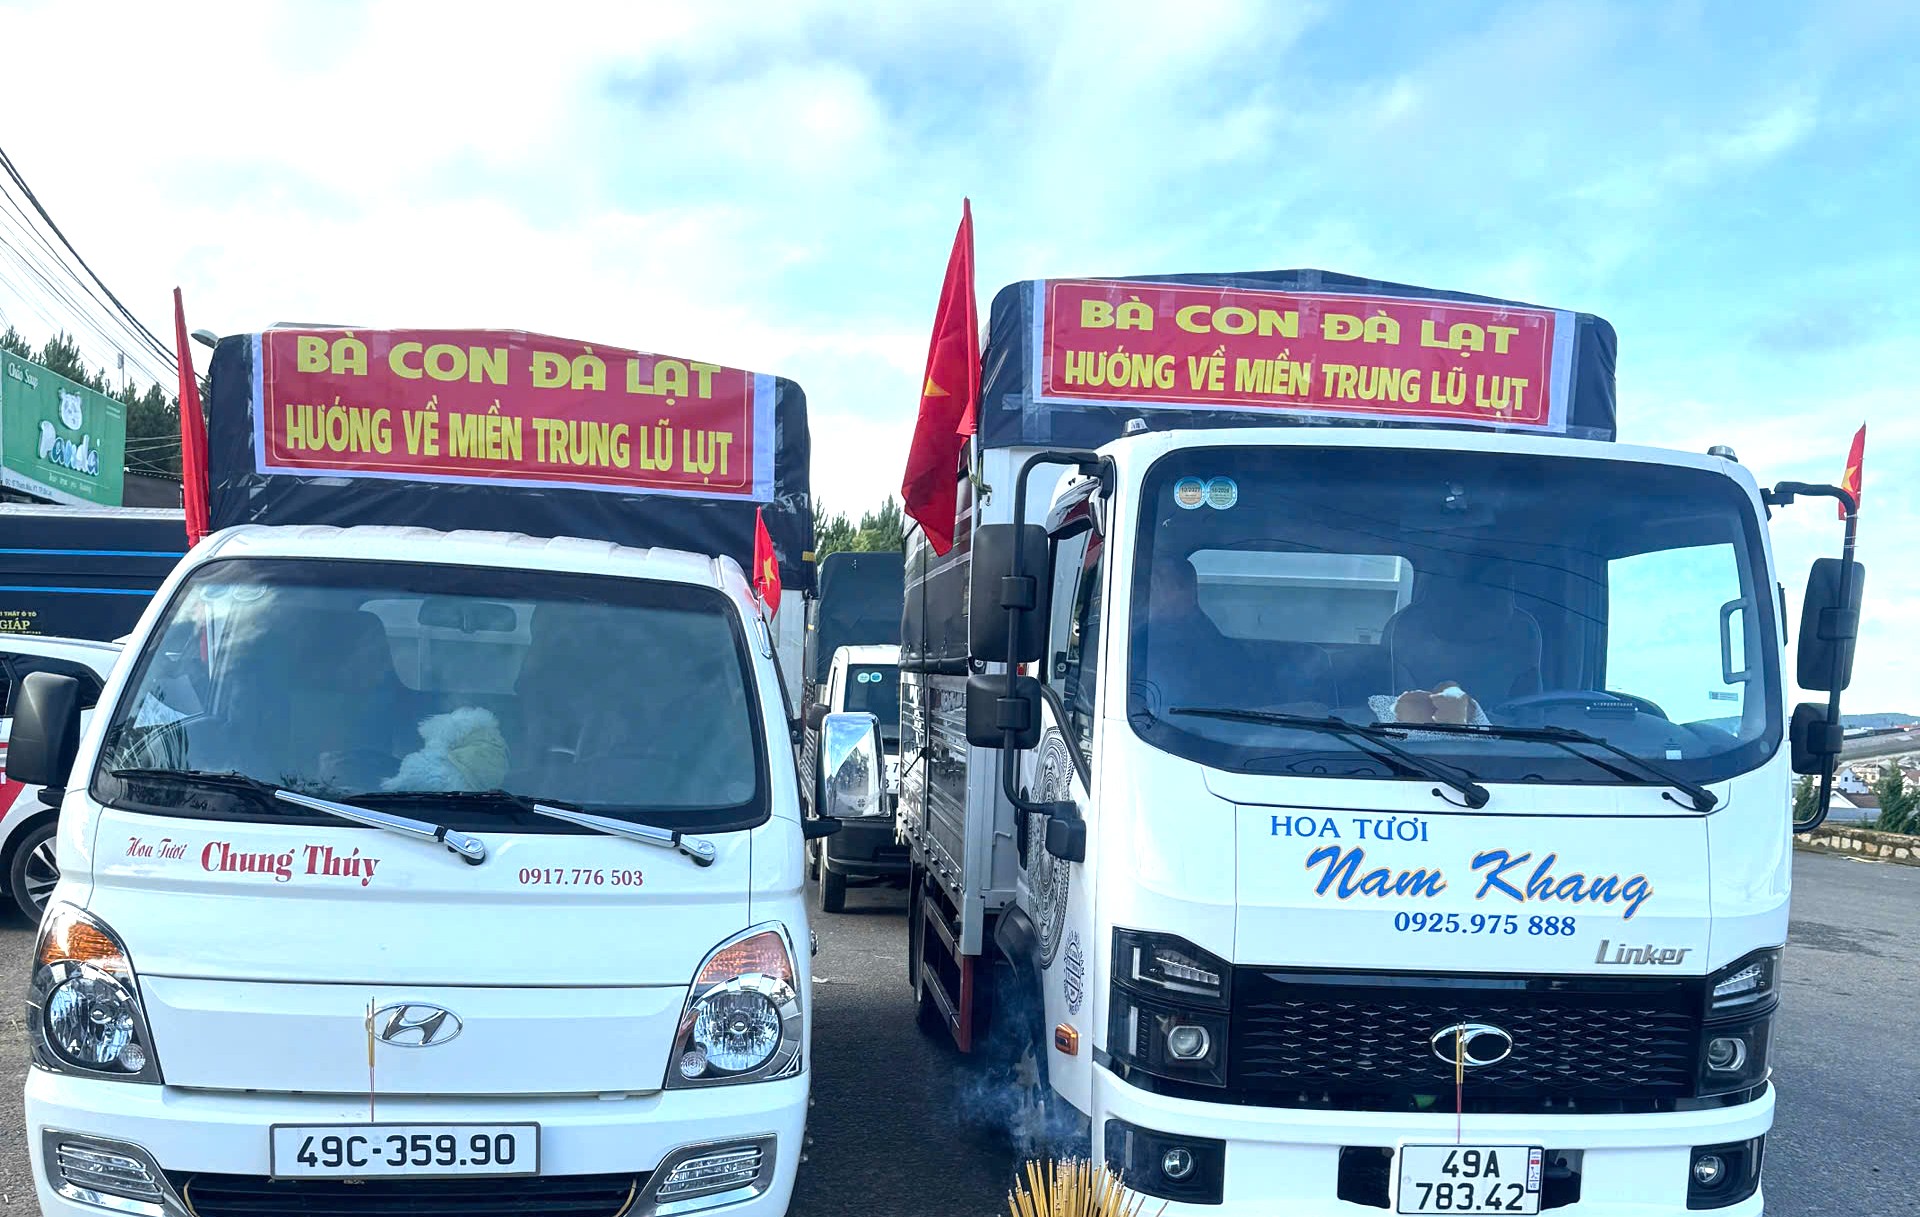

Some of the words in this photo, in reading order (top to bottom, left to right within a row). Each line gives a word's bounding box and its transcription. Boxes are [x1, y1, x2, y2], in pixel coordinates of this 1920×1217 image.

[1080, 295, 1154, 331] BÀ
[1175, 305, 1300, 338] CON
[1320, 309, 1401, 344] ĐÀ
[1421, 320, 1518, 358] LẠT
[297, 331, 367, 376] BÀ
[388, 342, 508, 385] CON
[529, 348, 606, 391] ĐÀ
[626, 360, 721, 405] LẠT
[1065, 346, 1175, 389] HƯỚNG
[1188, 344, 1225, 391] VỀ
[1235, 347, 1311, 396] MIỀN
[1322, 364, 1420, 403] TRUNG
[1430, 370, 1466, 405] LŨ
[1475, 376, 1528, 418] LỤT
[39, 420, 99, 476] Panda
[285, 396, 392, 454] HƯỚNG
[402, 395, 439, 456] VỀ
[448, 400, 523, 461] MIỀN
[532, 417, 630, 468] TRUNG
[639, 419, 673, 471] LŨ
[682, 430, 733, 484] LỤT
[0, 617, 30, 630] GIÁP
[1271, 815, 1341, 839] HOA
[1352, 815, 1429, 843] TƯƠI
[126, 836, 153, 858] Hoa
[200, 841, 296, 882] Chung
[302, 844, 381, 887] Thúy
[518, 868, 604, 885] 0917.776
[611, 869, 643, 886] 503
[1304, 844, 1448, 901] Nam
[1470, 849, 1655, 921] Khang
[1394, 911, 1519, 935] 0925.975
[1527, 915, 1577, 937] 888
[1594, 939, 1693, 966] Linker
[296, 1133, 516, 1168] 49C-359.90
[1441, 1149, 1500, 1178] 49A
[1415, 1182, 1524, 1211] 783.42
